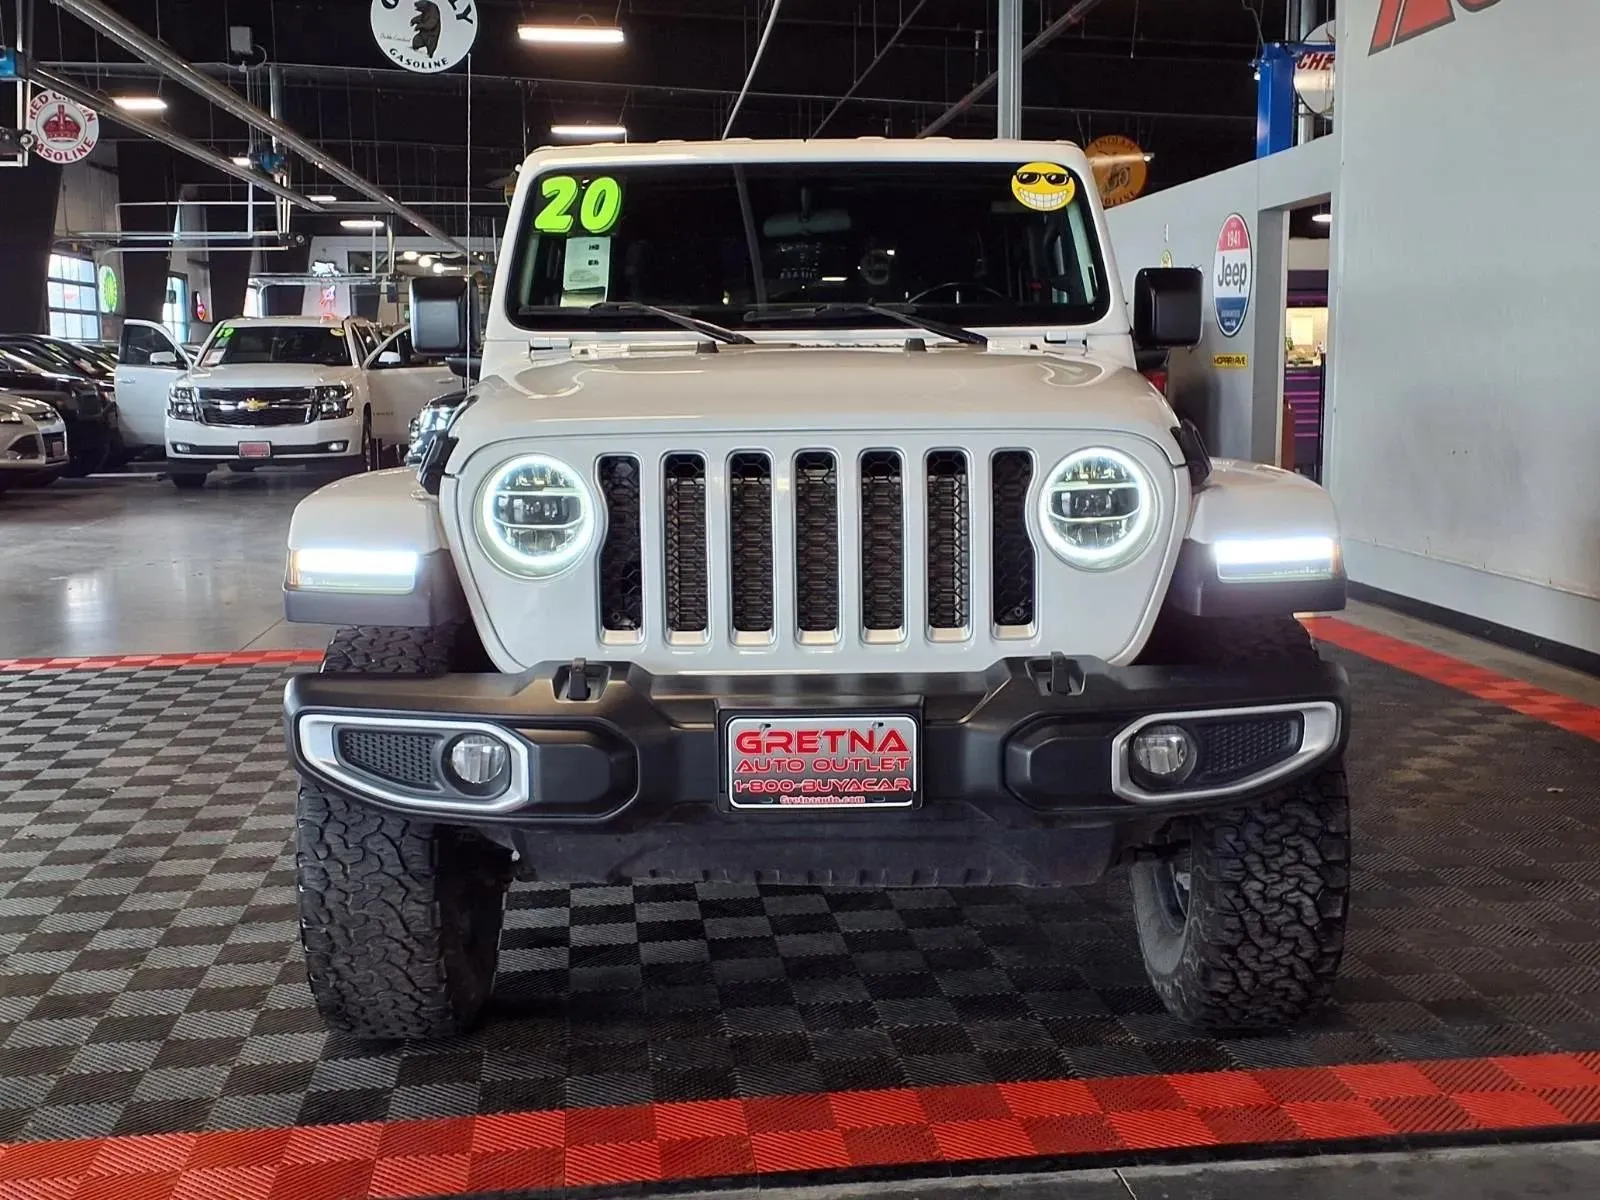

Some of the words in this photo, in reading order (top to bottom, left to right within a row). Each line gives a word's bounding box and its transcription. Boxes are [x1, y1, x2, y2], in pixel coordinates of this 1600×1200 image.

[389, 48, 449, 69] GASOLINE
[34, 136, 95, 162] ASOLINE
[534, 175, 622, 234] 20
[1227, 230, 1241, 248] 1941
[1217, 255, 1248, 294] Jeep
[735, 728, 909, 755] GRETNA
[734, 757, 806, 773] AUTO
[811, 756, 912, 773] OUTLET
[733, 777, 912, 793] 1-800-BUYACAR
